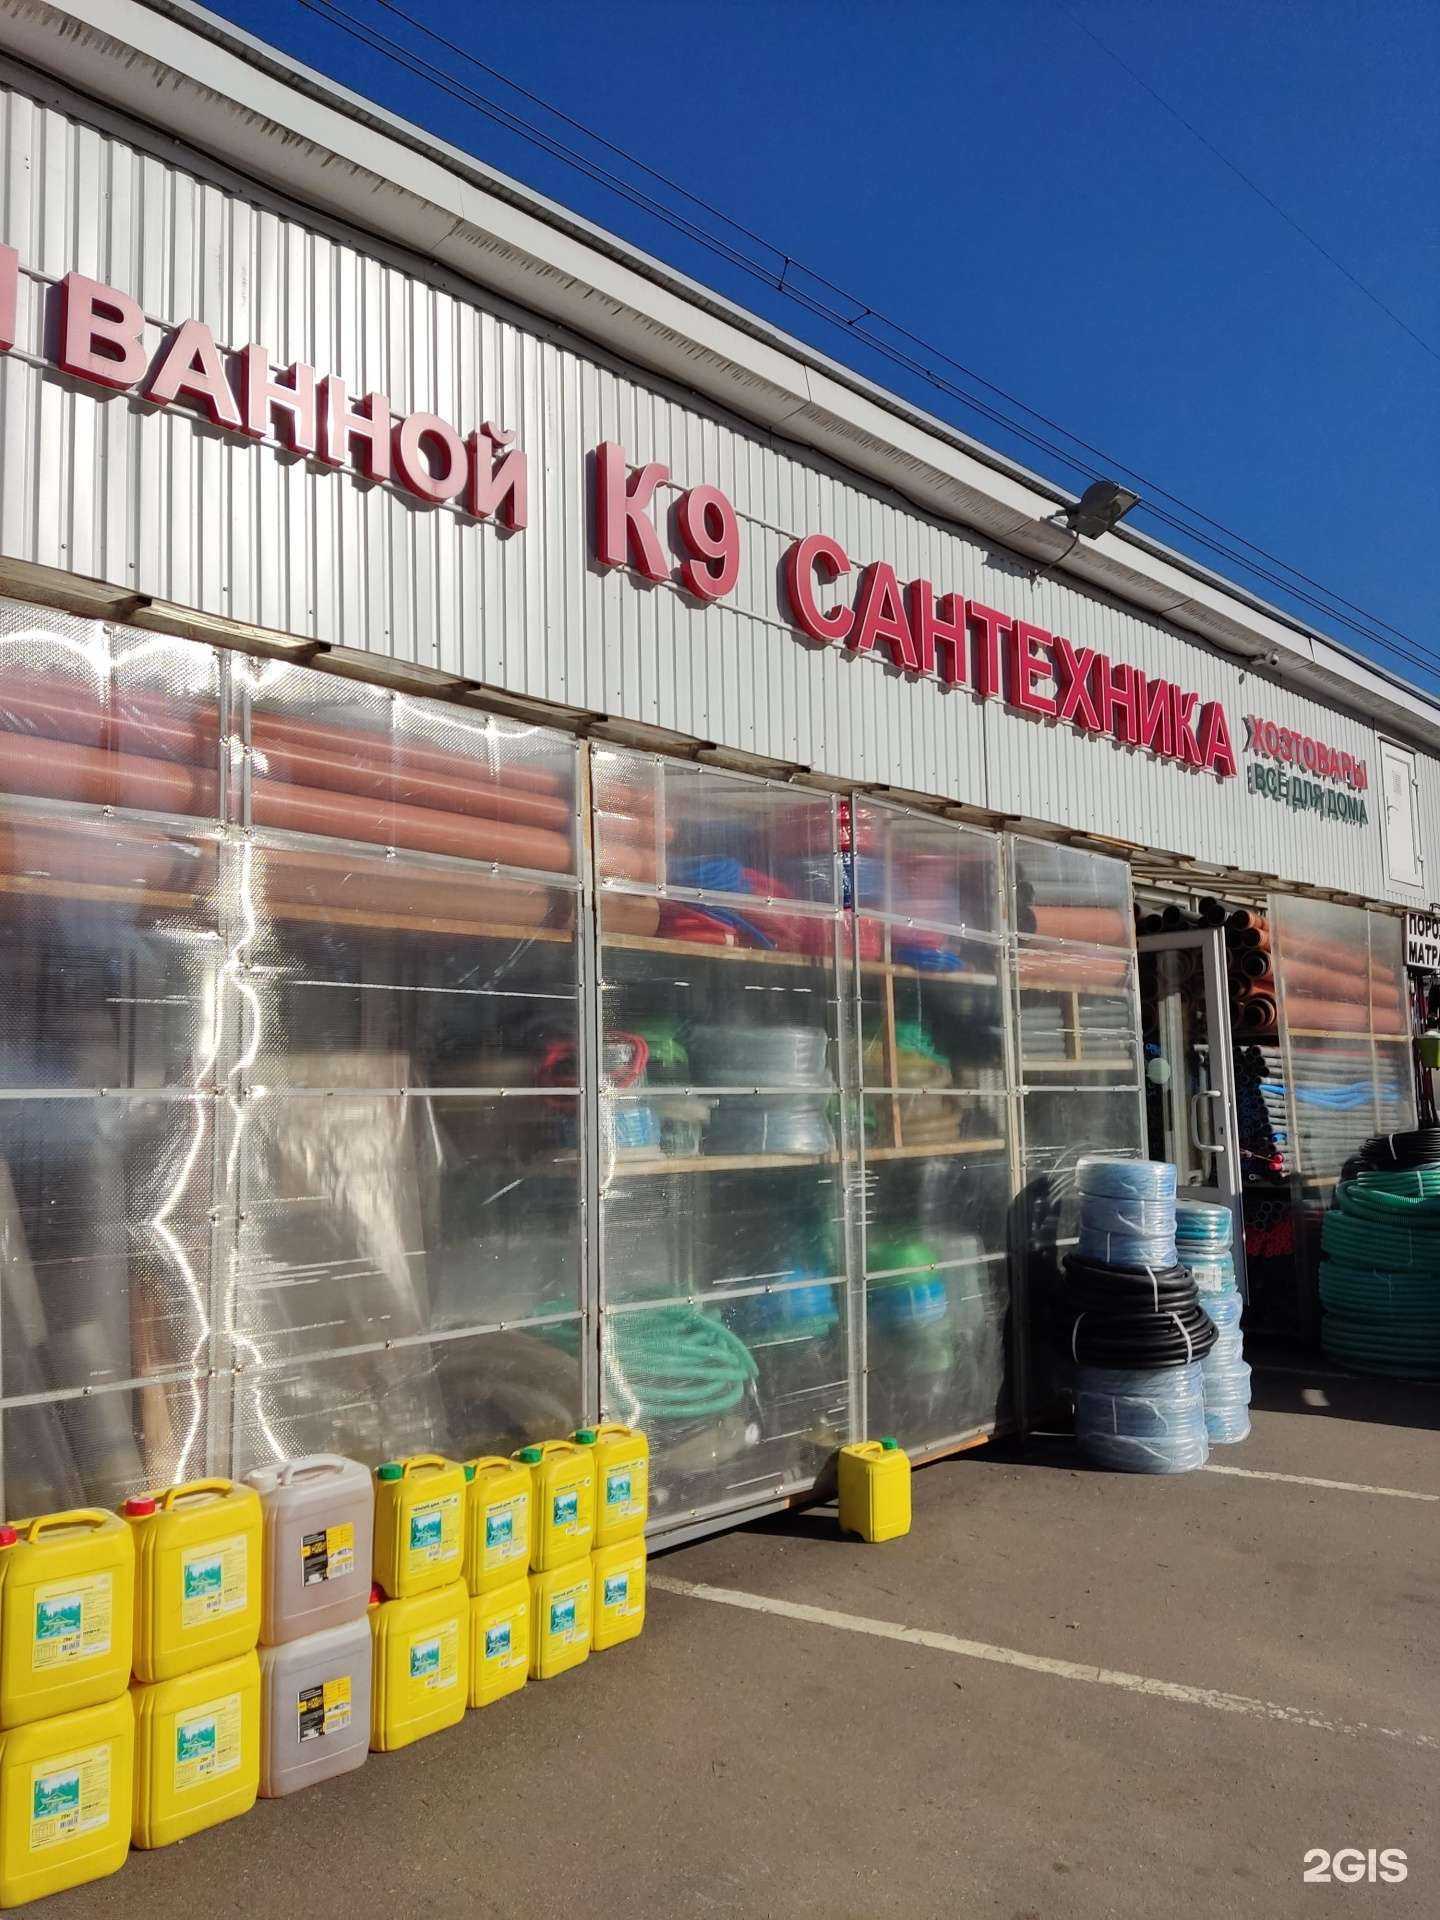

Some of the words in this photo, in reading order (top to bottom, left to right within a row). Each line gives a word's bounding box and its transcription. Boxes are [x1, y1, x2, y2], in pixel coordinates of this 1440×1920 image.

[60, 271, 528, 532] ВАННОЙ
[596, 440, 740, 602] К9
[787, 534, 1238, 778] САНТЕХНИКА
[1323, 787, 1369, 825] ДОМА
[1408, 913, 1440, 940] ПОРО
